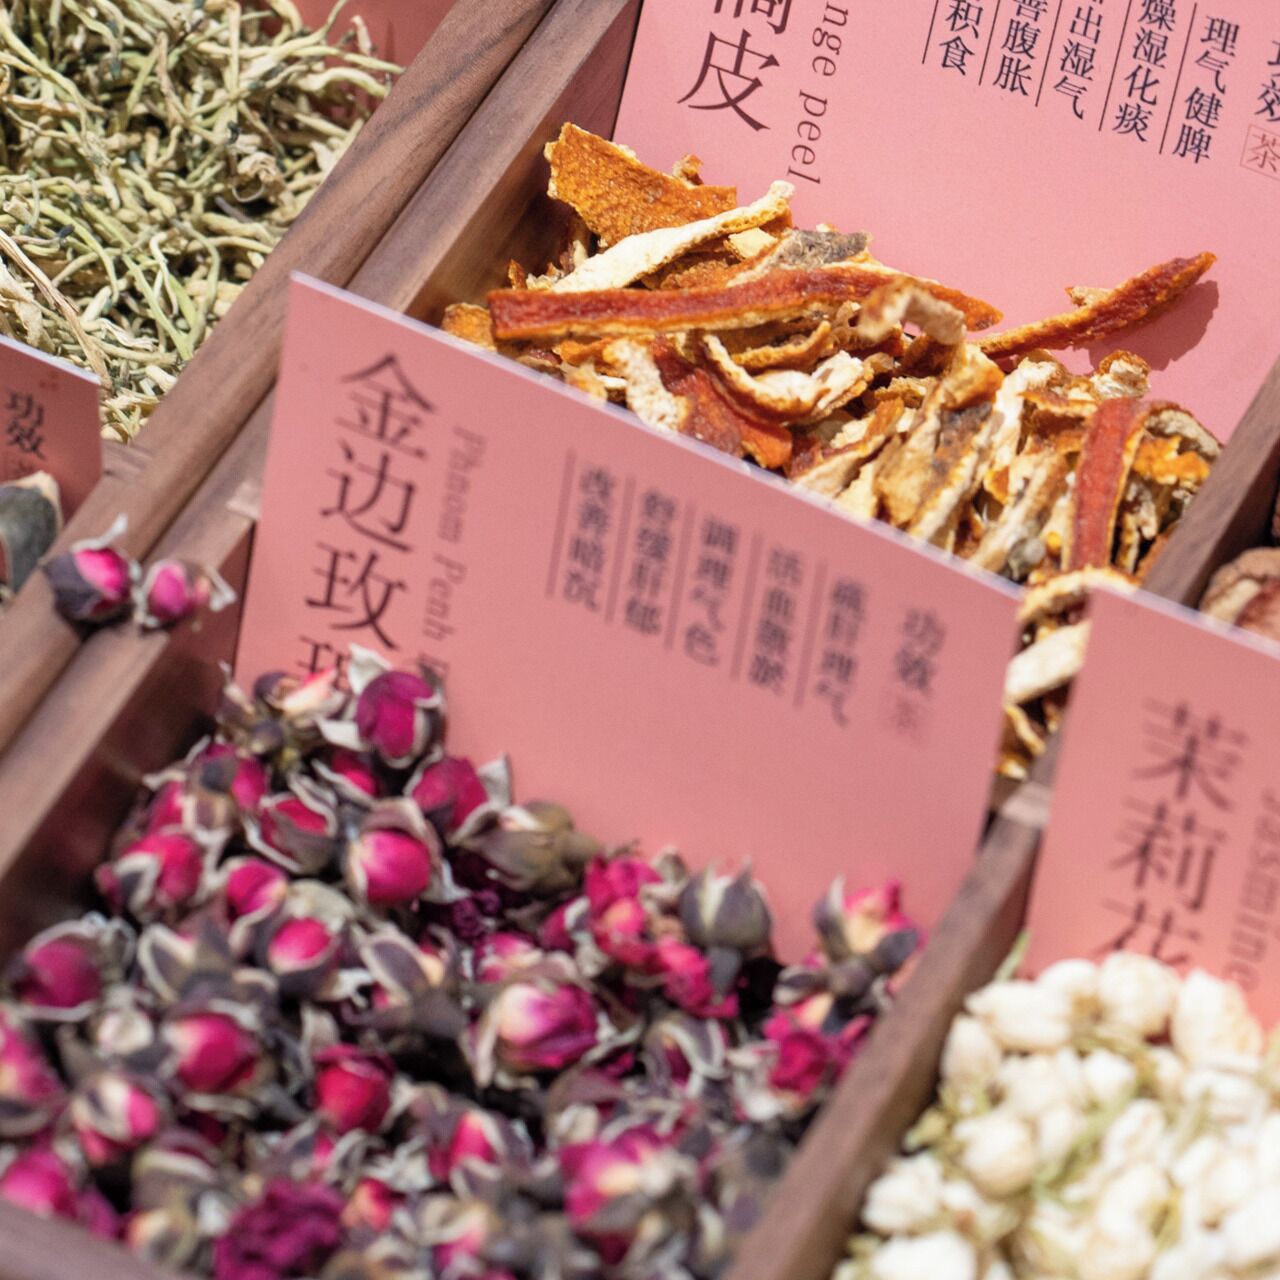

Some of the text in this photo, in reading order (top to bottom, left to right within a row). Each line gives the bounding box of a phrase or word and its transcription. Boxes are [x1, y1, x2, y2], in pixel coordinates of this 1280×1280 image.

[1172, 11, 1241, 166] 理气健脾
[787, 90, 829, 185] peel
[4, 388, 49, 462] 功效
